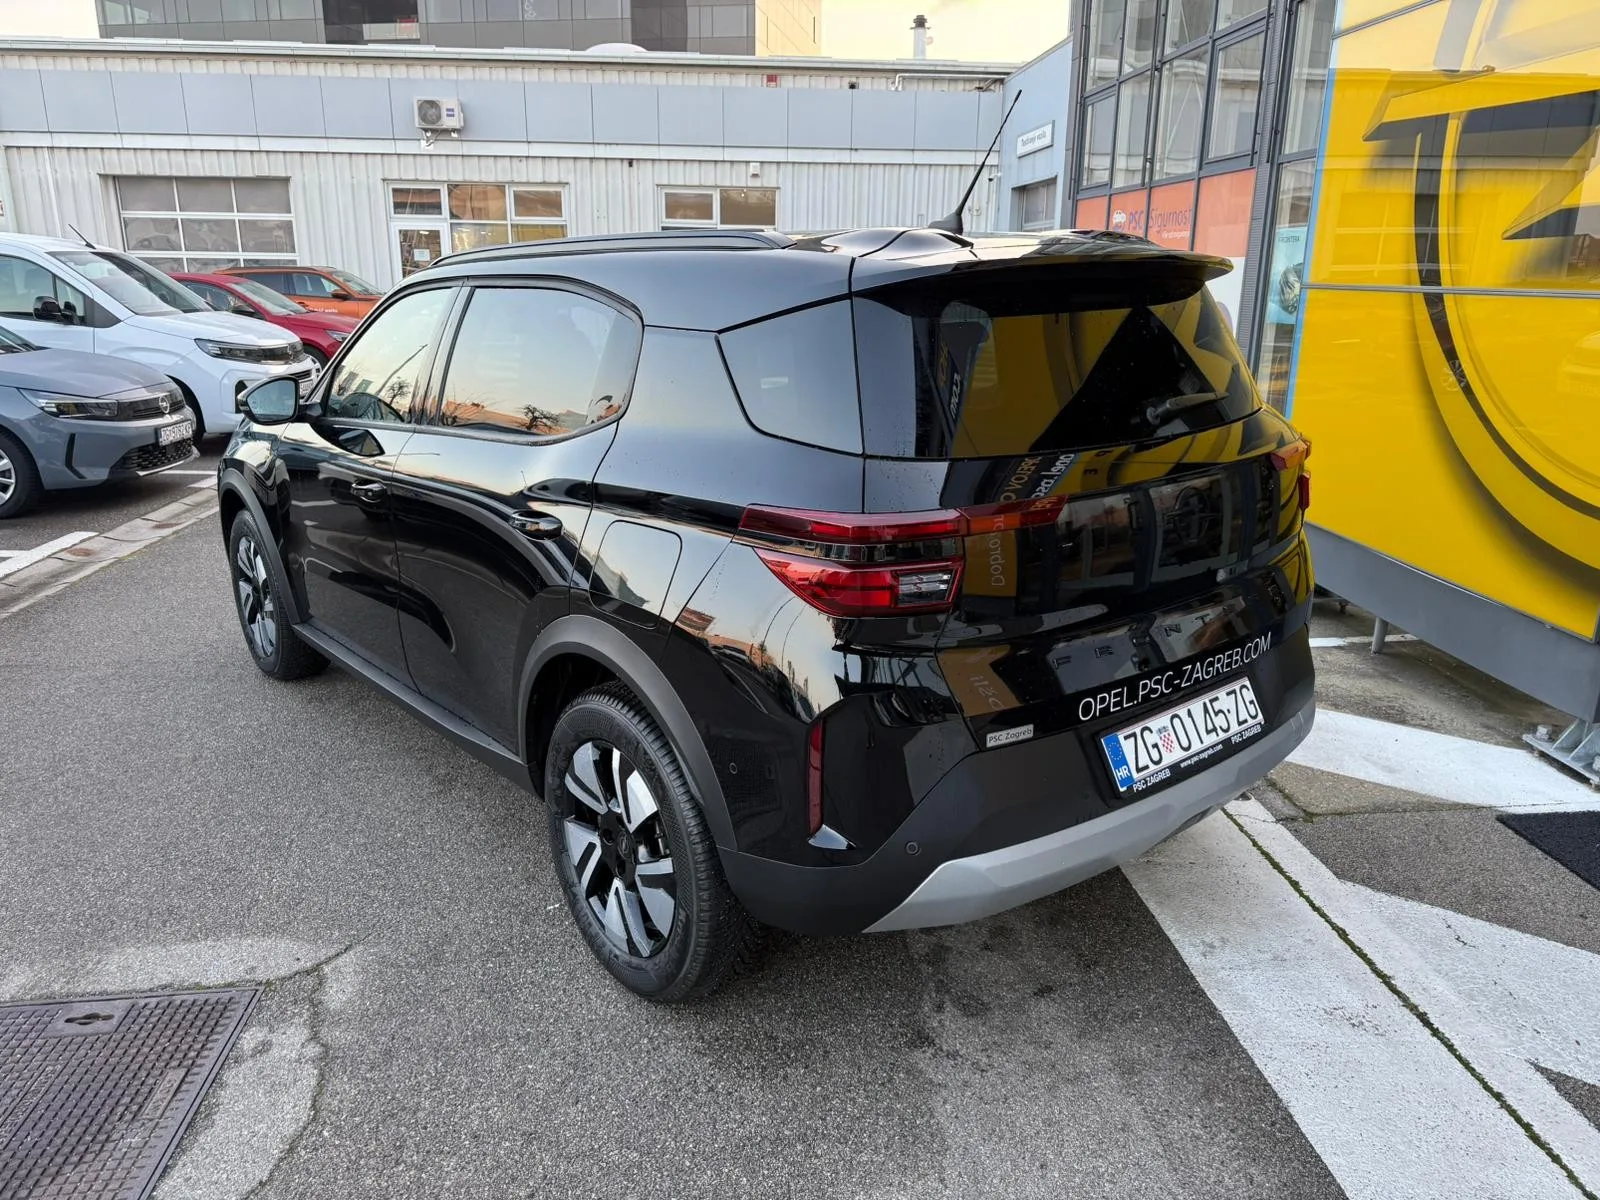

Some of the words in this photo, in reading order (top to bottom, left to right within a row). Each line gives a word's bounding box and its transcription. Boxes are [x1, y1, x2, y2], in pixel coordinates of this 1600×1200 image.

[1078, 631, 1272, 721] OPEL.PSC-ZAGREB.COM
[988, 733, 1003, 744] PSC
[1005, 728, 1032, 741] Zagreb
[1230, 734, 1243, 745] PSC
[1242, 725, 1262, 740] ZAGREB
[1123, 725, 1164, 775] ZG
[1115, 764, 1131, 781] HR
[1132, 780, 1147, 793] PSC
[1146, 768, 1171, 786] ZAGREB
